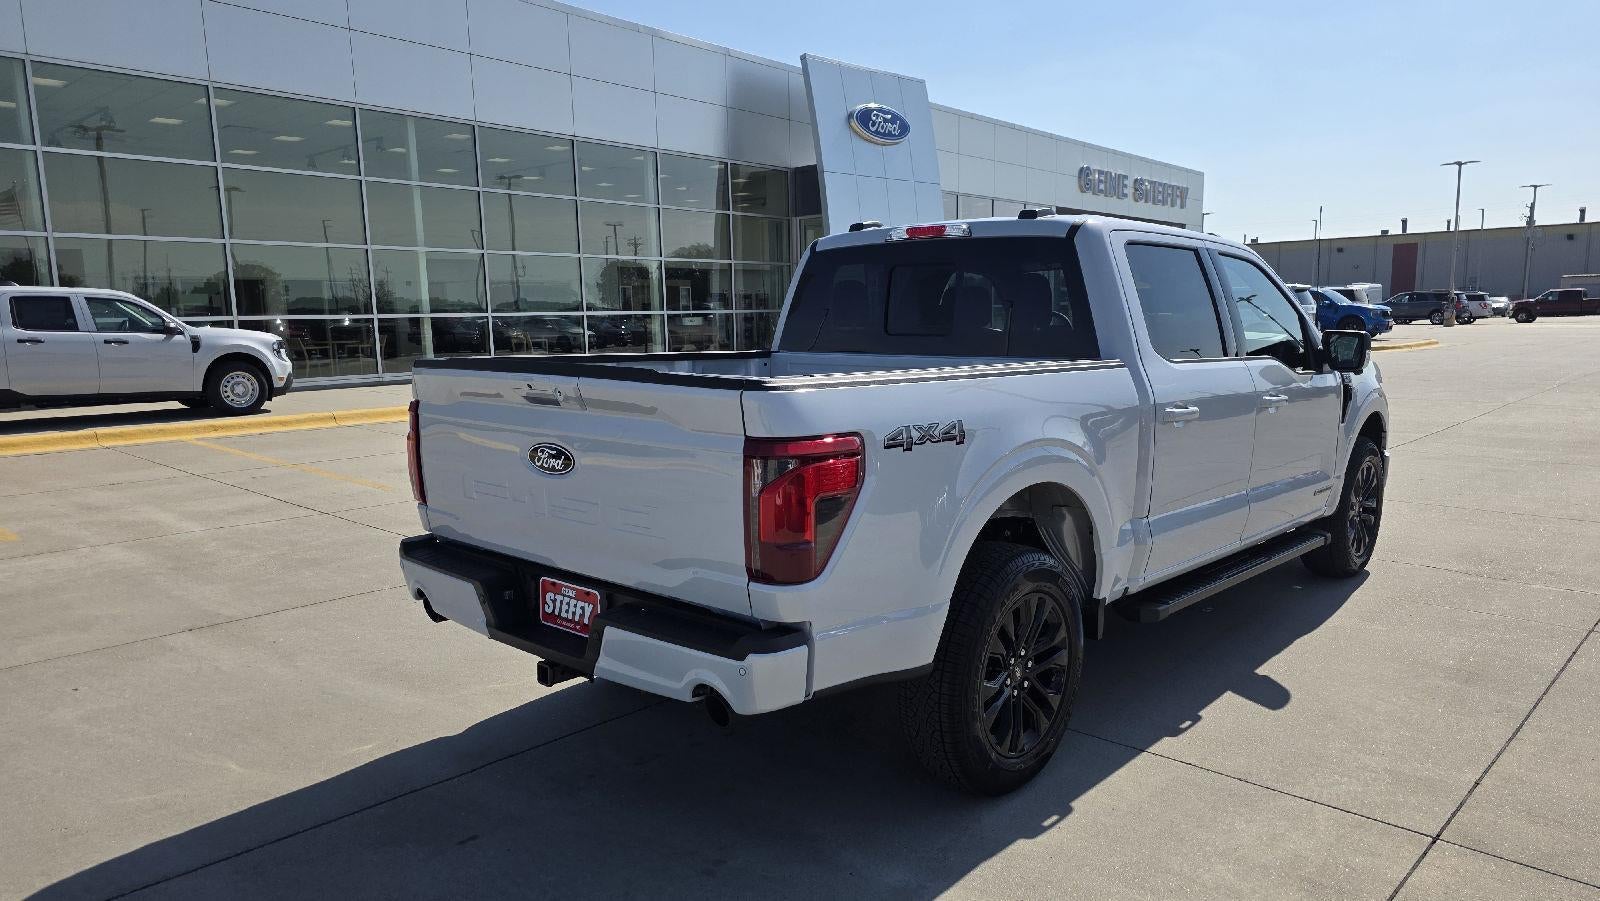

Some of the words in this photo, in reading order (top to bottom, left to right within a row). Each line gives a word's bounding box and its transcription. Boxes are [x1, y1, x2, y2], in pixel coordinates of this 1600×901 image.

[869, 111, 900, 135] Ford
[1078, 164, 1128, 200] GENE
[1133, 176, 1190, 209] STEFFY
[535, 447, 564, 470] Ford
[561, 587, 577, 598] GENE
[544, 592, 594, 625] STEFFY
